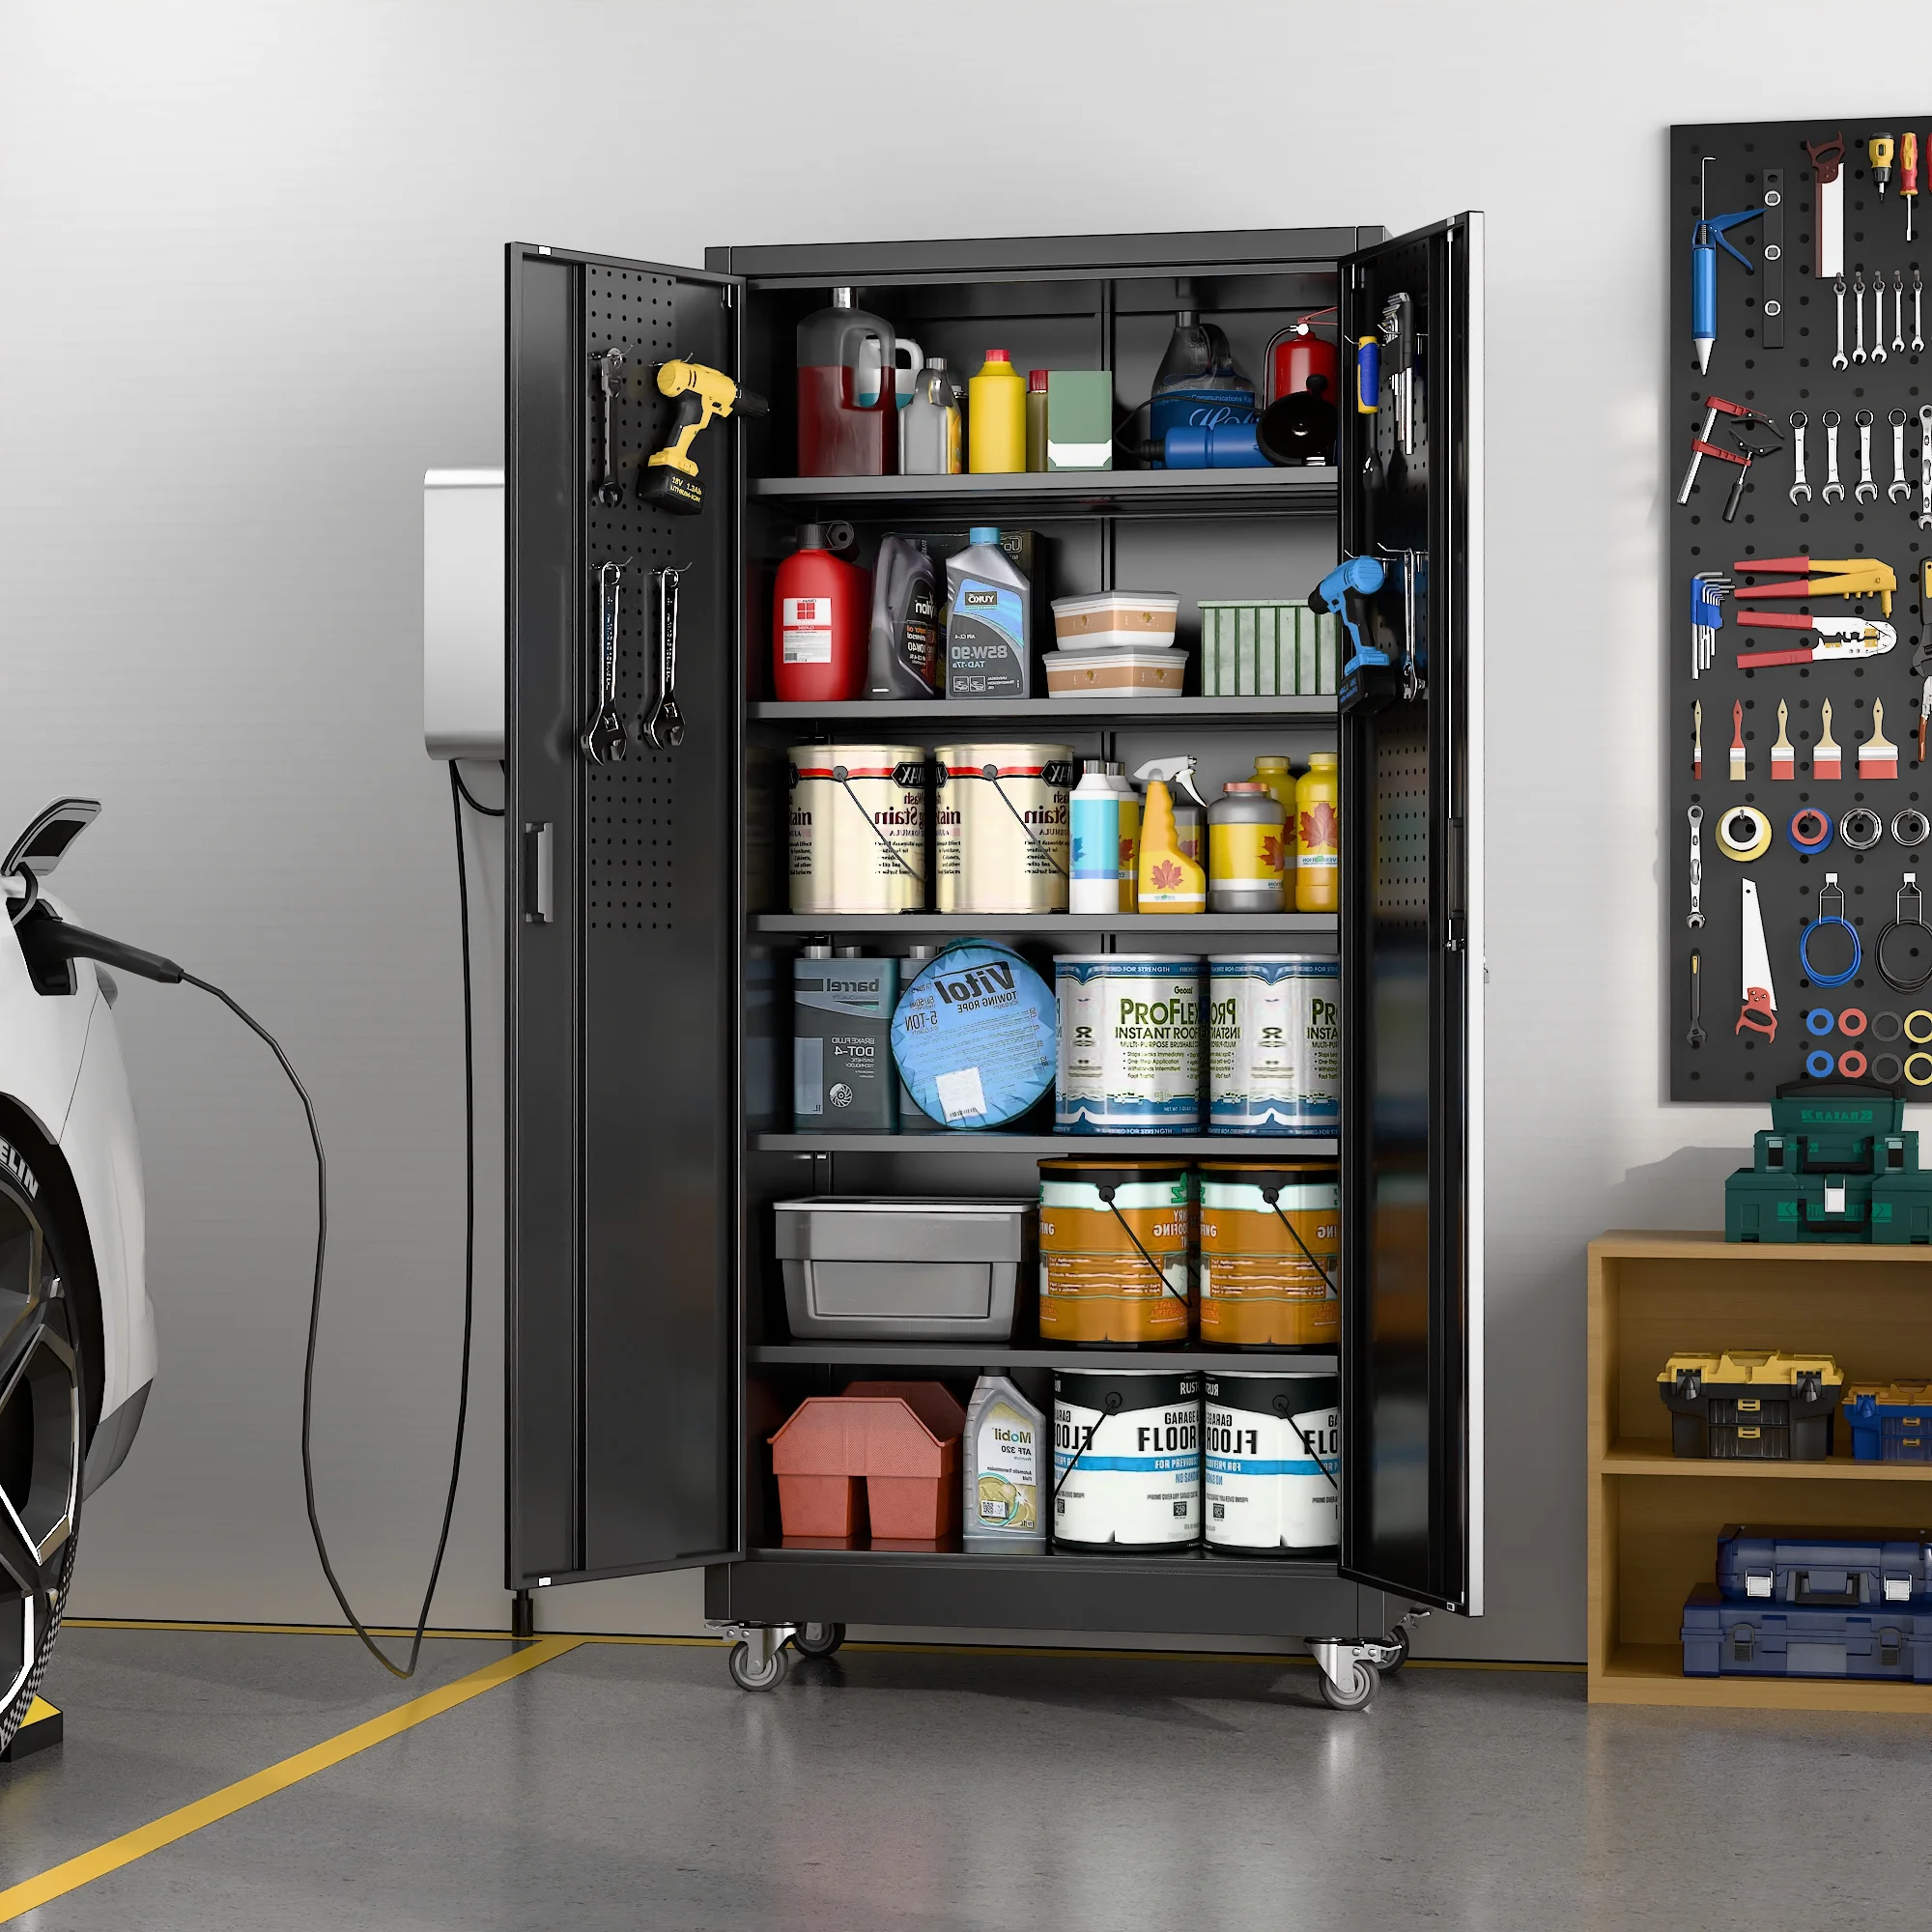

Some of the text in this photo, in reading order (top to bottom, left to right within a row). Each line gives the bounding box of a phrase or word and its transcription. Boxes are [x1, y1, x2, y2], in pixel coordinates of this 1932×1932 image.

[671, 476, 683, 486] 18V
[670, 484, 702, 502] LITHIUM-ION
[1312, 998, 1338, 1025] PR
[1115, 1027, 1171, 1039] INSTANT
[1307, 1027, 1338, 1039] INSTA
[0, 1138, 41, 1199] ELIN
[1164, 1411, 1196, 1425] GARAGE
[1137, 1425, 1197, 1452] FLOOR
[1304, 1429, 1338, 1455] FLO
[1154, 1460, 1171, 1469] FOR
